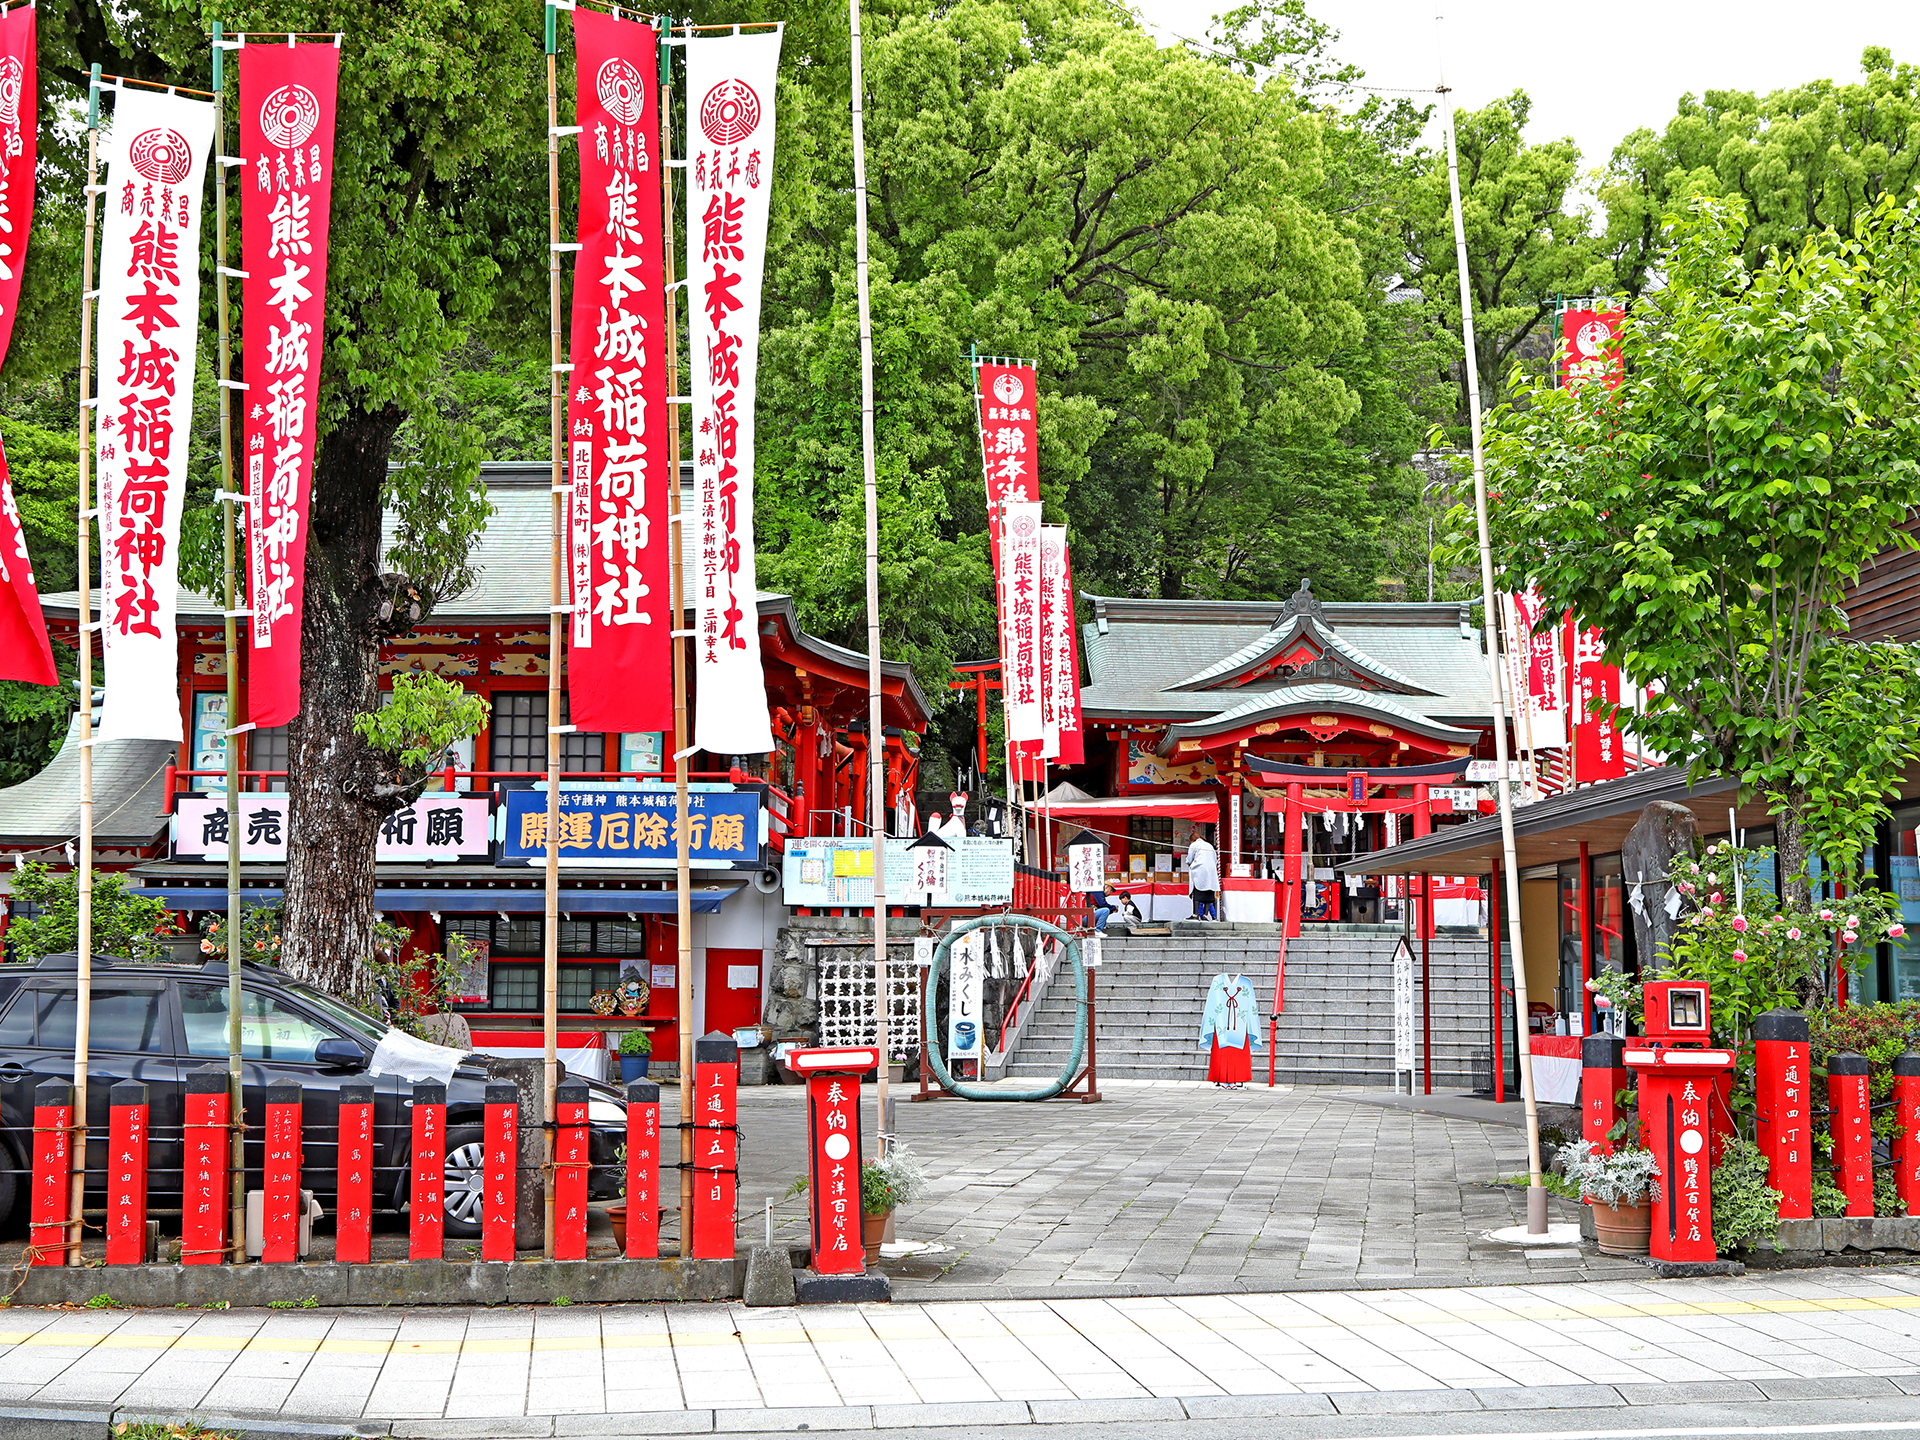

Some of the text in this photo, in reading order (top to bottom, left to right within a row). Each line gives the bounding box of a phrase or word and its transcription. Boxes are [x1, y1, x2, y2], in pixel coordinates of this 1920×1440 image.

[256, 144, 322, 195] 商売繁昌
[594, 121, 649, 173] 商売繁昌
[121, 180, 190, 229] 商売繁昌
[101, 414, 116, 462] 奉納
[113, 220, 181, 640] 熊本城稲荷神社
[265, 192, 313, 624] 熊本城稲荷神社
[573, 385, 593, 437] 奉納
[592, 169, 651, 627] 熊本城稲荷神社
[250, 403, 270, 638] 奉納 南区近見 昭和タクシー合資会社
[574, 448, 590, 532] 北区植木町
[699, 417, 718, 663] 奉納 北区清水新地六丁目 三浦幸夫
[1014, 552, 1034, 704] 熊本城稲荷神社
[203, 808, 463, 846] 商売祈願
[520, 812, 744, 851] 開運厄除祈願
[791, 839, 843, 850] 運を開くために
[959, 948, 975, 1016] 水みくじ
[503, 1108, 513, 1142] 朝市場
[707, 1073, 725, 1201] 上通町五丁目
[1785, 1046, 1801, 1163] 上通町四丁目
[826, 1081, 848, 1251] 奉納 大洋百貨店
[1681, 1081, 1702, 1242] 奉納 鶴屋百貨店
